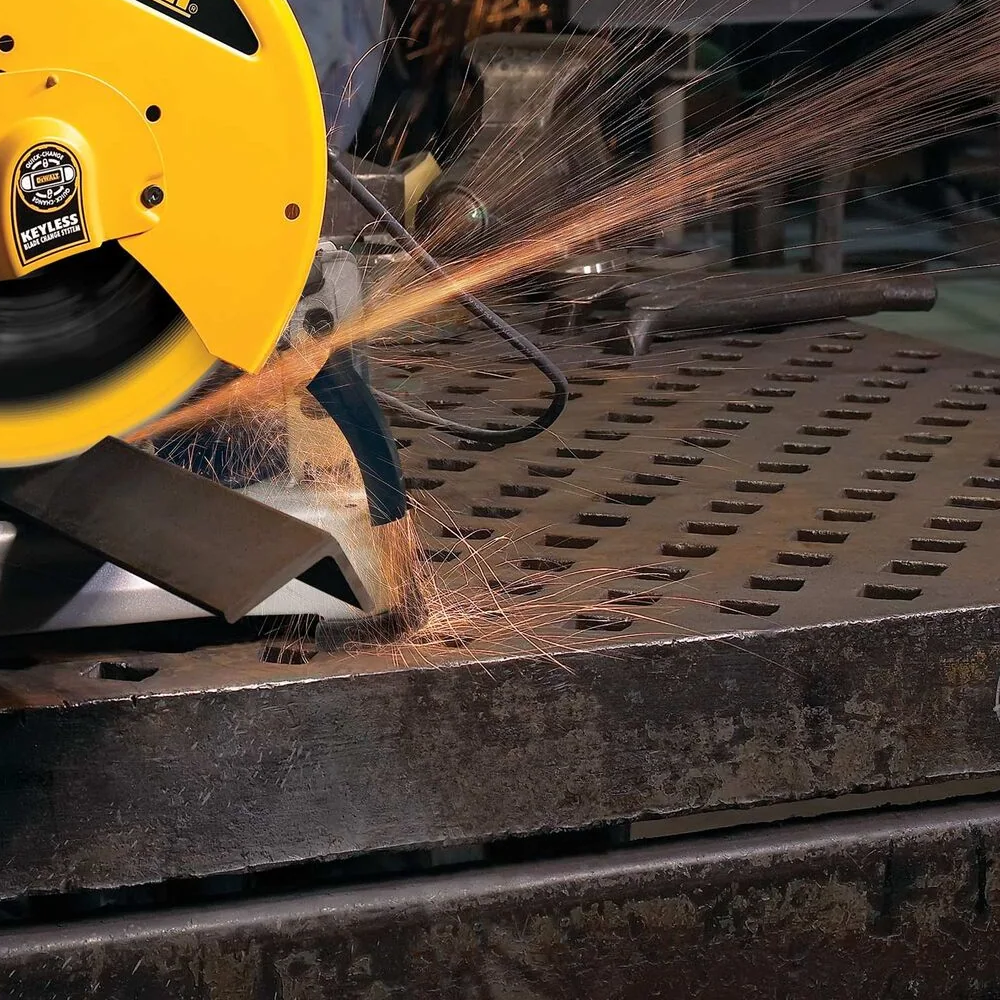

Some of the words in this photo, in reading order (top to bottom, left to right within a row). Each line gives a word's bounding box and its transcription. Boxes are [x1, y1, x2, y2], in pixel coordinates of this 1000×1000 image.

[25, 150, 65, 169] QUICK-CHANGE
[20, 213, 79, 243] KEYLESS
[23, 238, 41, 250] BLADE
[40, 230, 61, 244] CHANGE
[61, 224, 81, 236] SYSTEM
